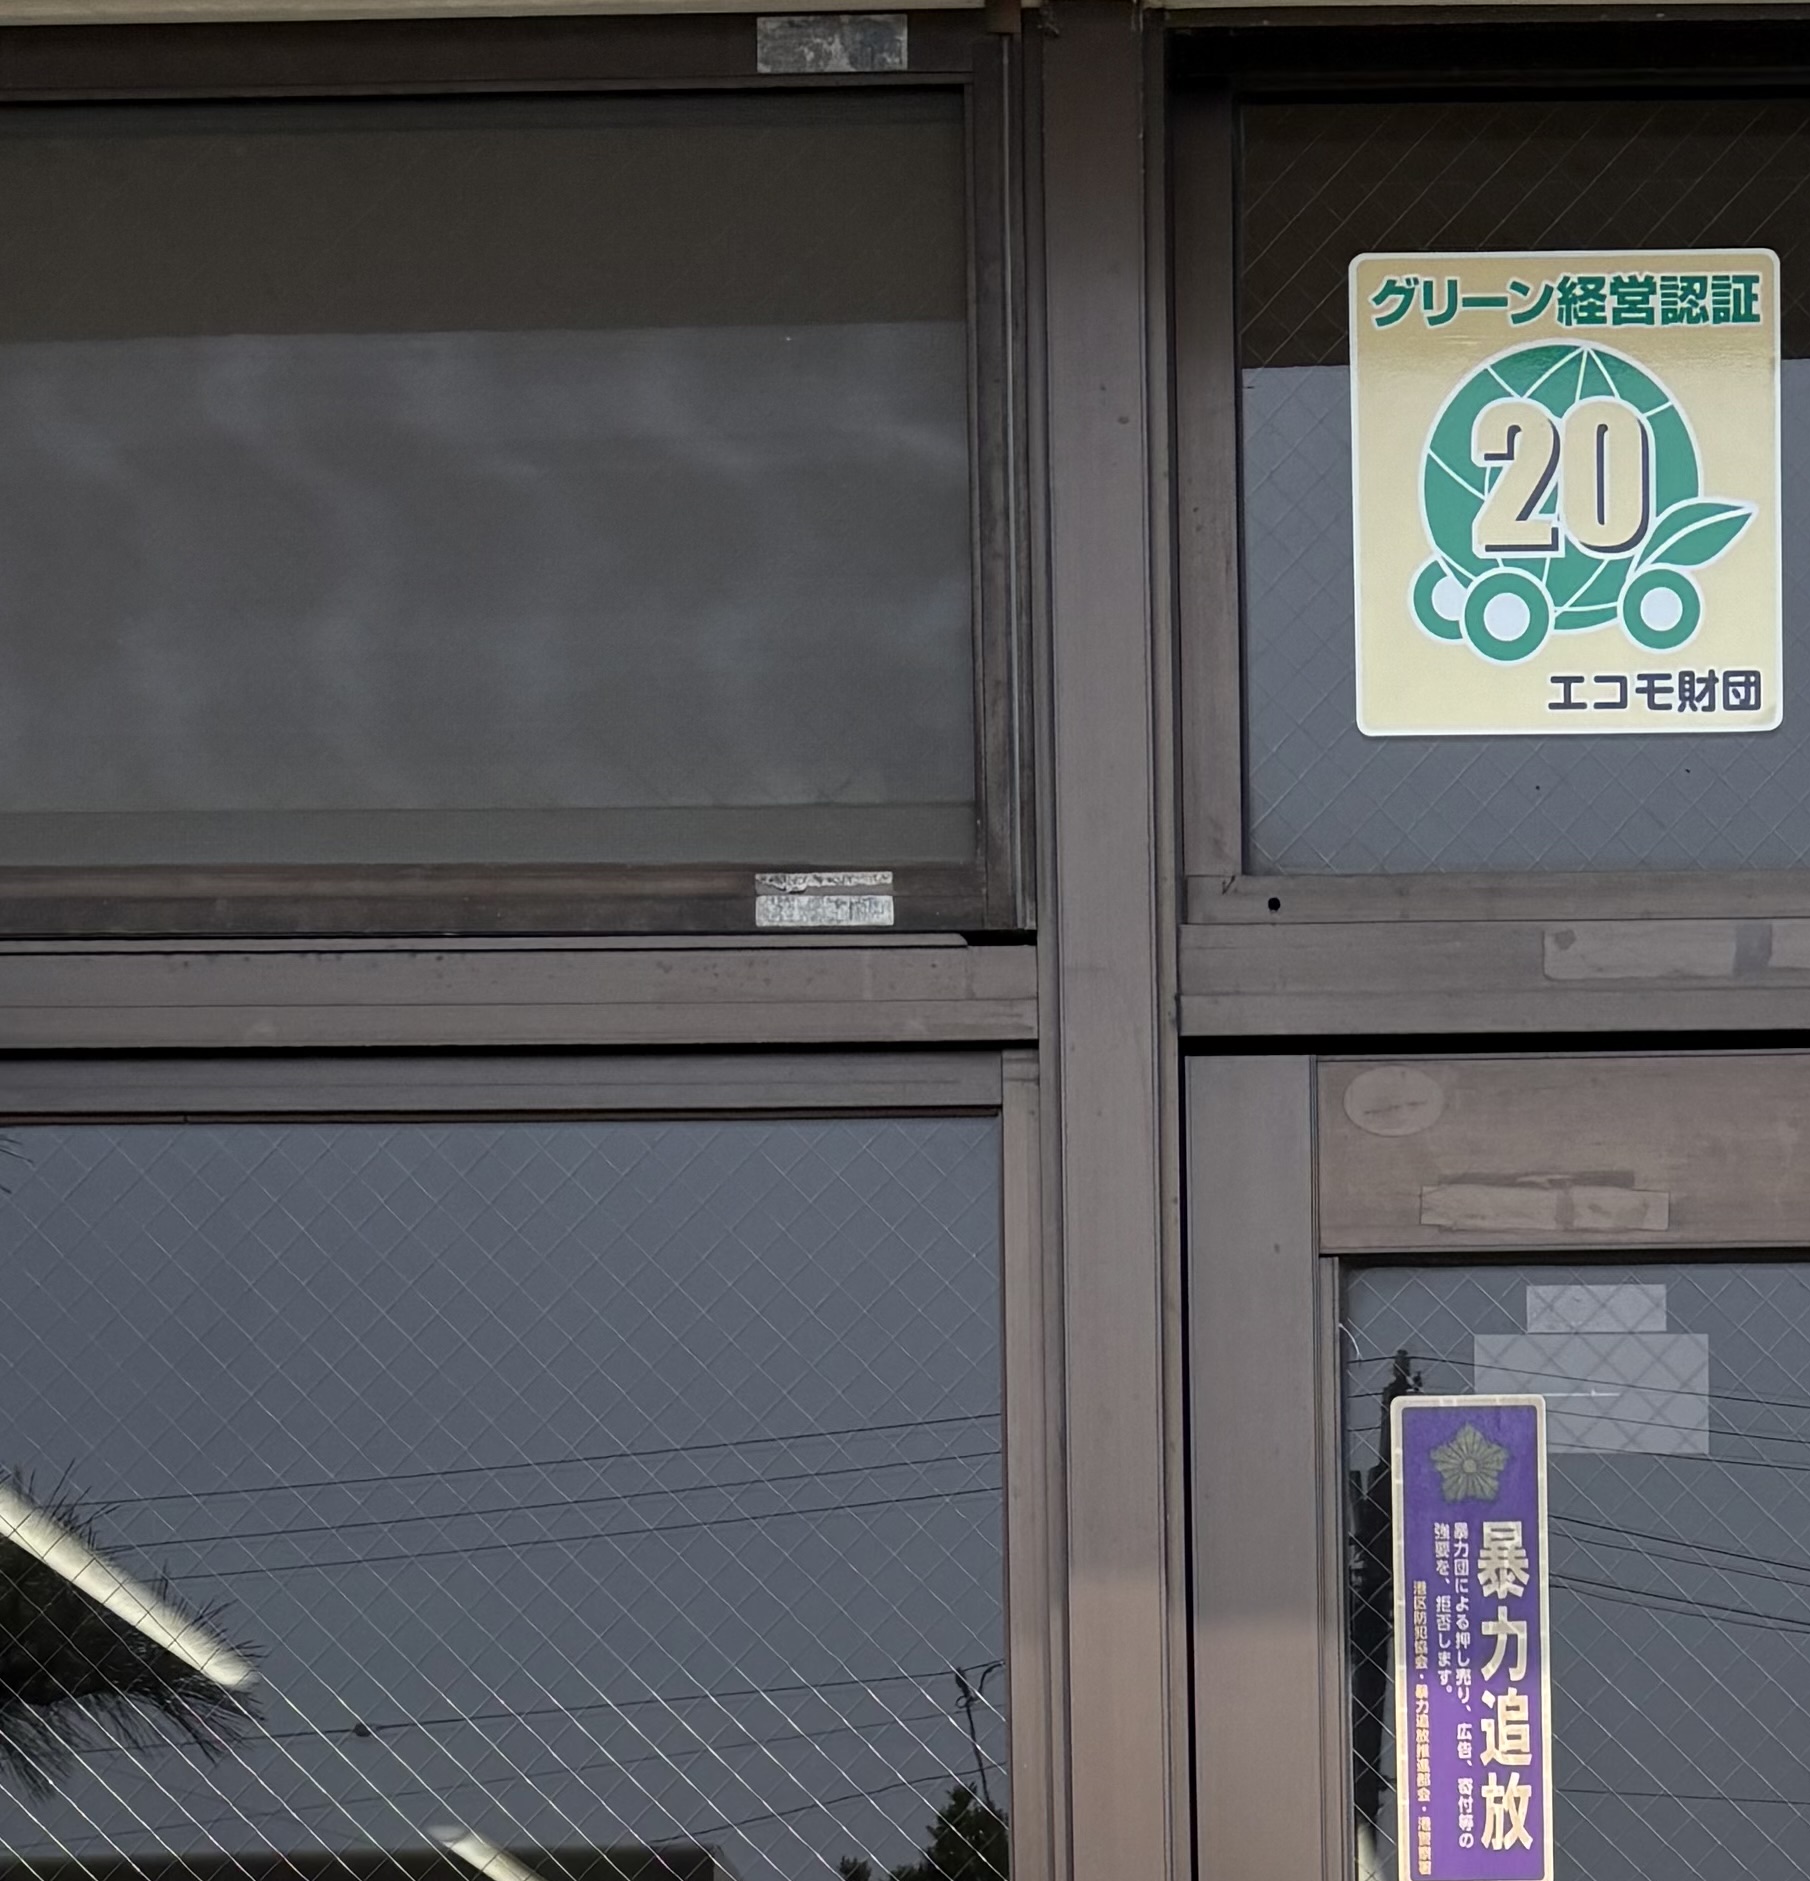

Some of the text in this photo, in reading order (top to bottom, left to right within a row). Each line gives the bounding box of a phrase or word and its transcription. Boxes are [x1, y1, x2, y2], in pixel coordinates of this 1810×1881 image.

[1371, 274, 1762, 328] グリーン経営認証
[1472, 396, 1656, 560] 20
[1547, 669, 1763, 713] エコモ財団
[1477, 1520, 1533, 1852] 暴力追放
